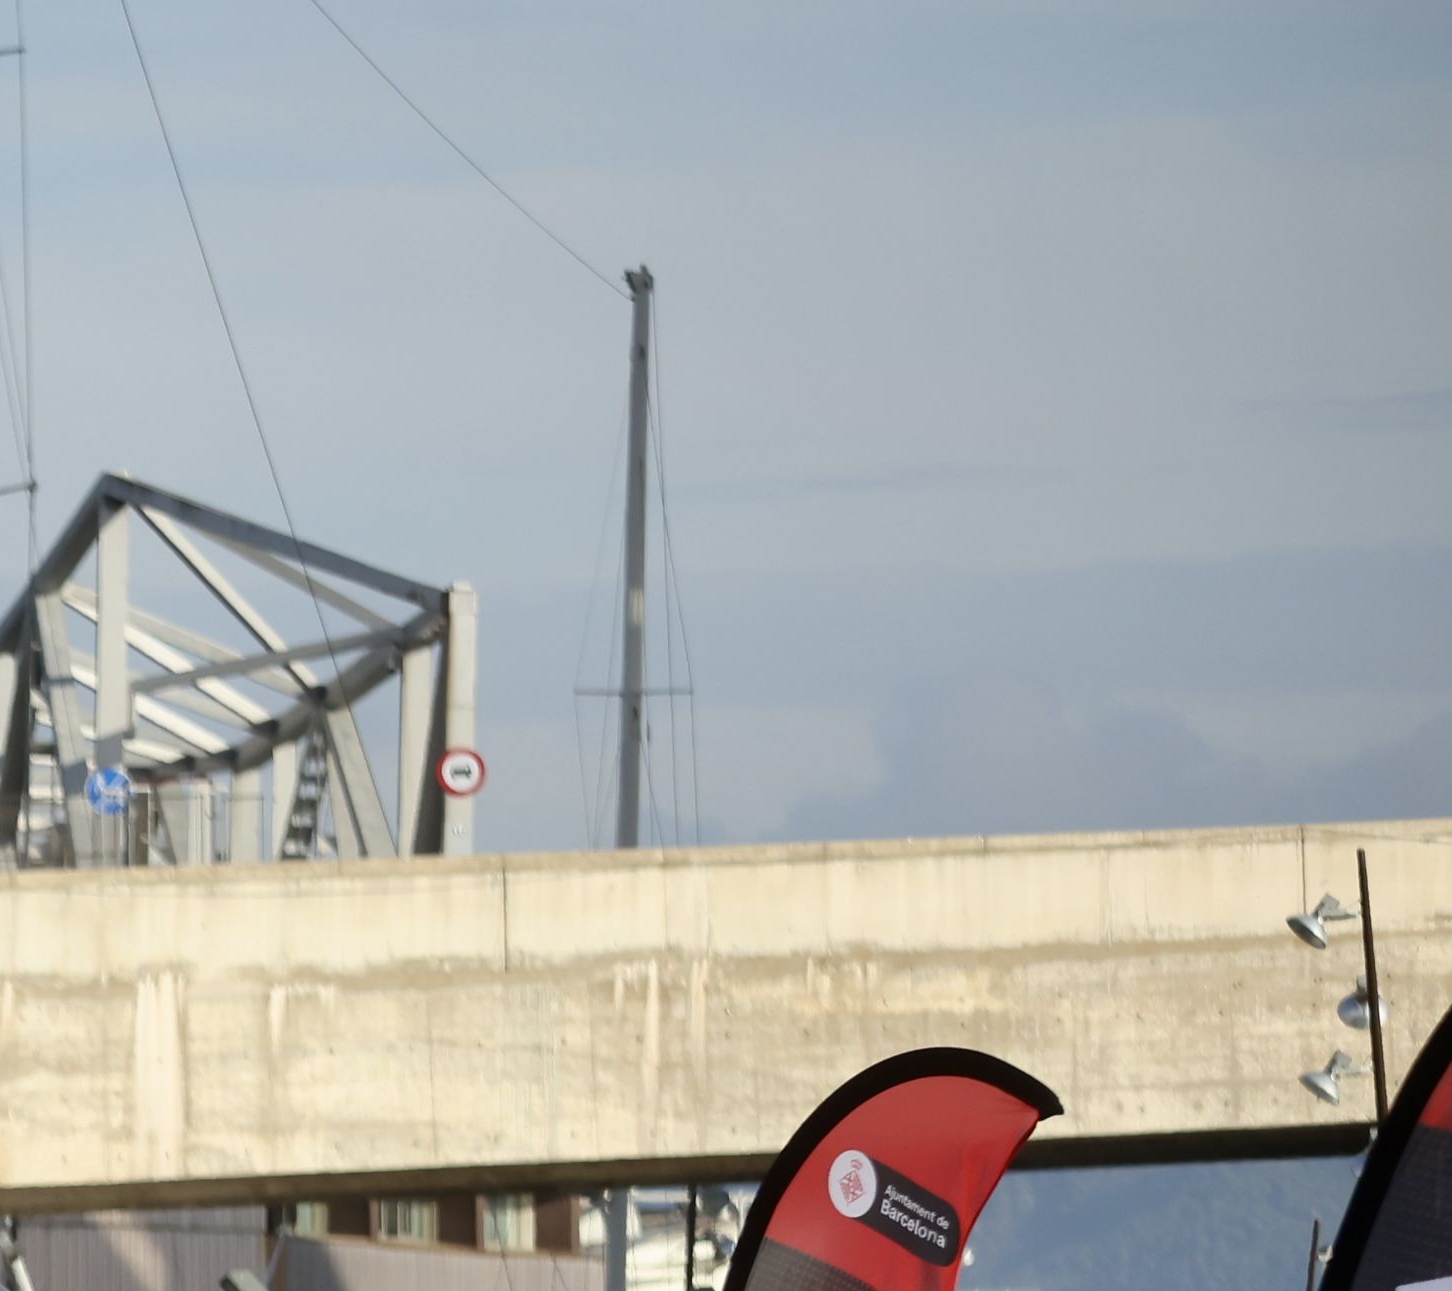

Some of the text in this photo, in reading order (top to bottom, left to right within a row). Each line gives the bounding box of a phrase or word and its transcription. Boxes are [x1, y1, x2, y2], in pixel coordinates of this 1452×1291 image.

[880, 1199, 946, 1248] Barcelona
[885, 1185, 949, 1230] Ajuntament de
